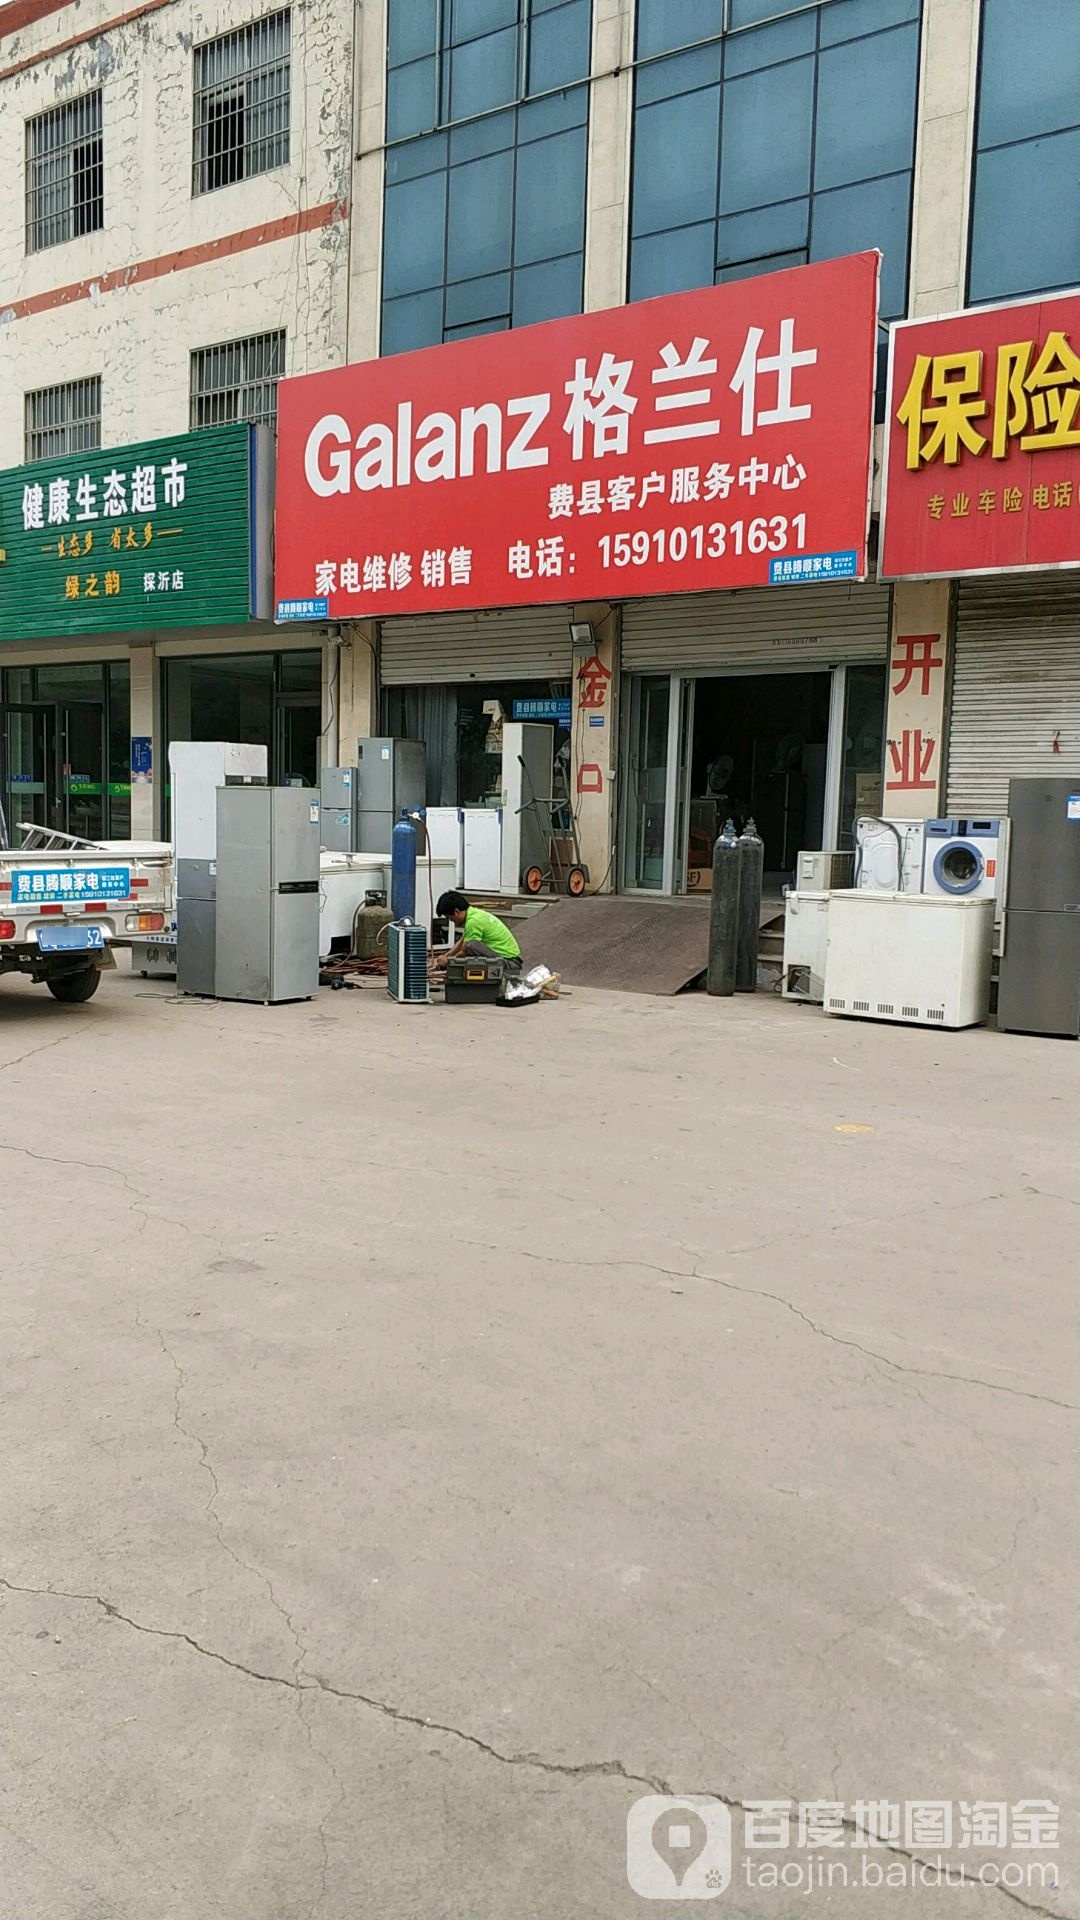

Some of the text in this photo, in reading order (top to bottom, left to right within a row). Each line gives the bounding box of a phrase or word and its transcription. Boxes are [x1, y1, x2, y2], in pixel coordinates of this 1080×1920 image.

[304, 317, 818, 499] Galanz 格兰仕
[896, 331, 1080, 470] 保险
[22, 457, 189, 530] 健康生态超市
[547, 453, 808, 520] 费县客户服务中心
[65, 569, 121, 599] 绿之韵
[143, 568, 185, 593] 探沂店
[314, 557, 413, 597] 家电维修
[420, 546, 473, 588] 销售
[597, 512, 808, 569] 15910131631
